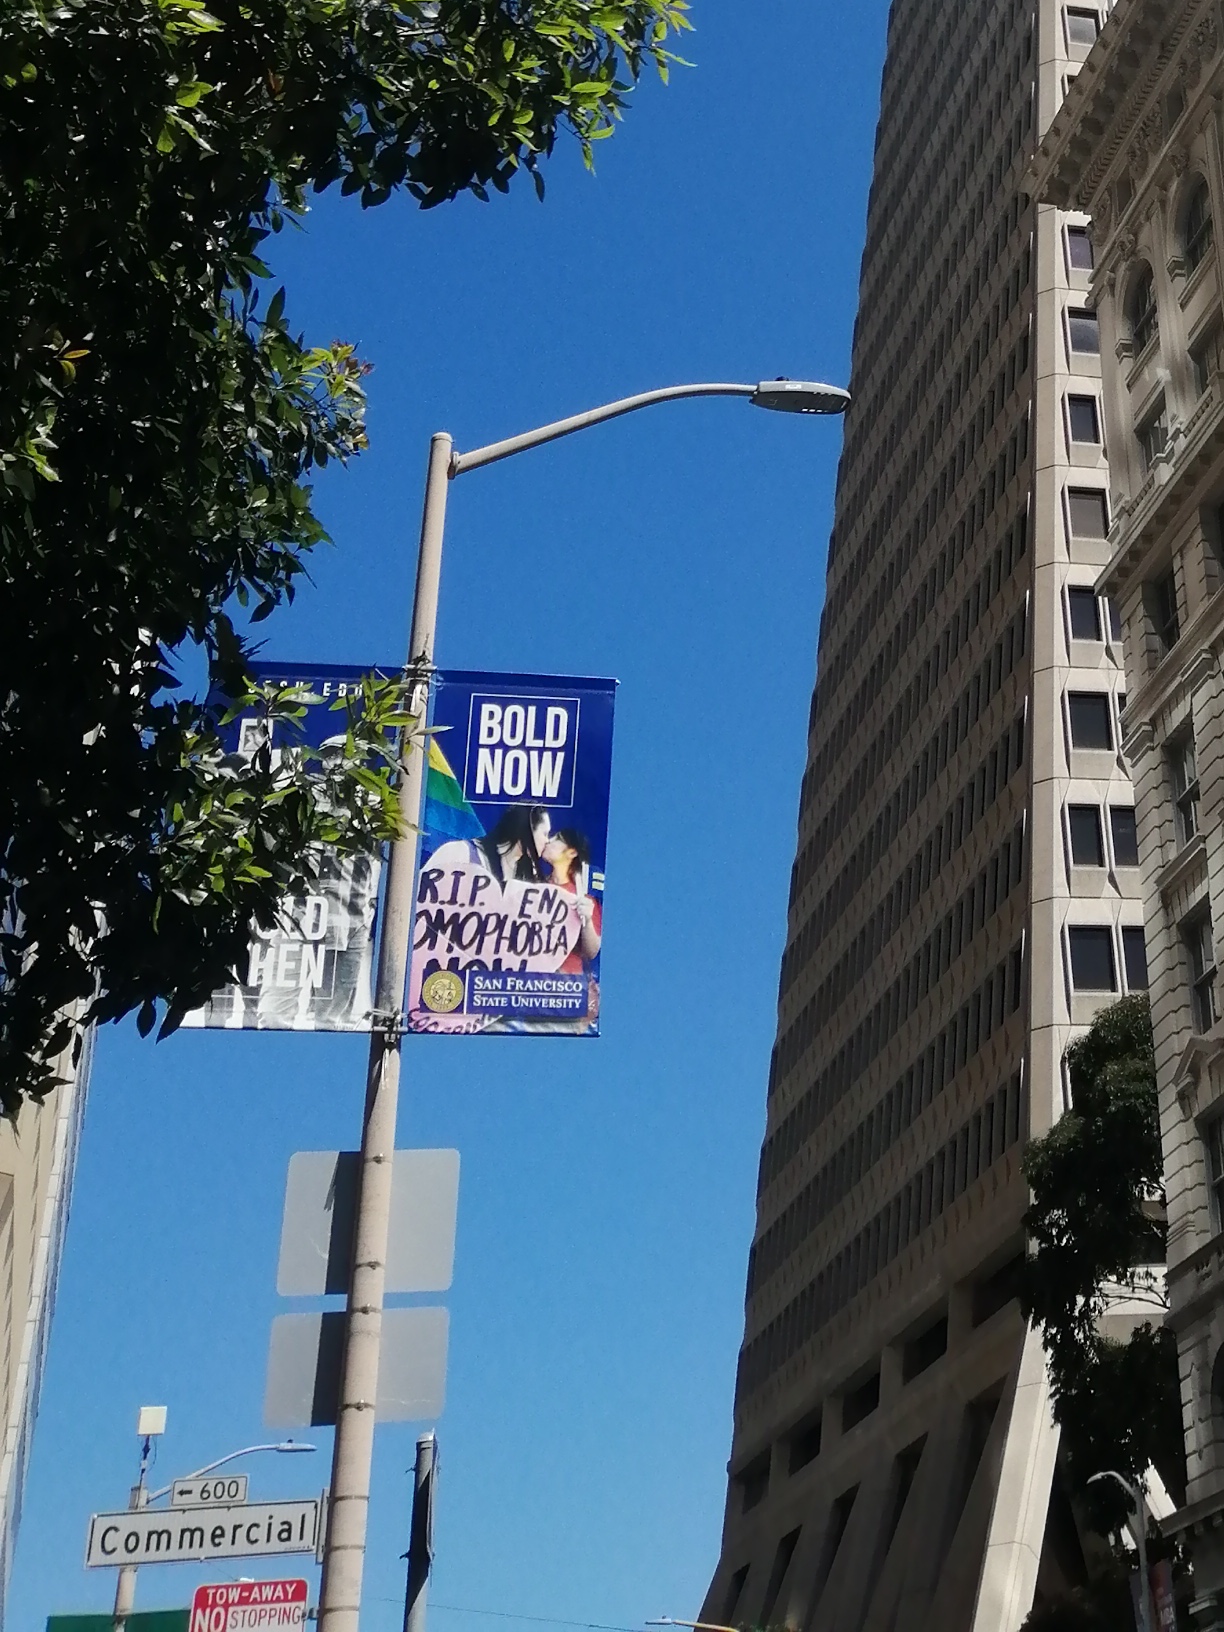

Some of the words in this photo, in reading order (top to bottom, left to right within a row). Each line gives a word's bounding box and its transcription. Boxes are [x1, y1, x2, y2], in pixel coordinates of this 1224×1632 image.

[479, 703, 568, 748] BOLD
[475, 748, 565, 797] NOW
[417, 868, 491, 907] R.I.P.
[518, 888, 568, 924] END
[247, 942, 326, 988] HEN
[473, 994, 508, 1007] STATE
[511, 996, 582, 1009] UNIVERSITY
[474, 976, 502, 990] SAN
[506, 977, 583, 992] FRANCISCO
[200, 1480, 239, 1500] 600
[101, 1513, 306, 1555] Commercial
[207, 1582, 297, 1606] TOW-AWAY
[193, 1606, 226, 1632] NO
[229, 1606, 302, 1629] STOPPING
